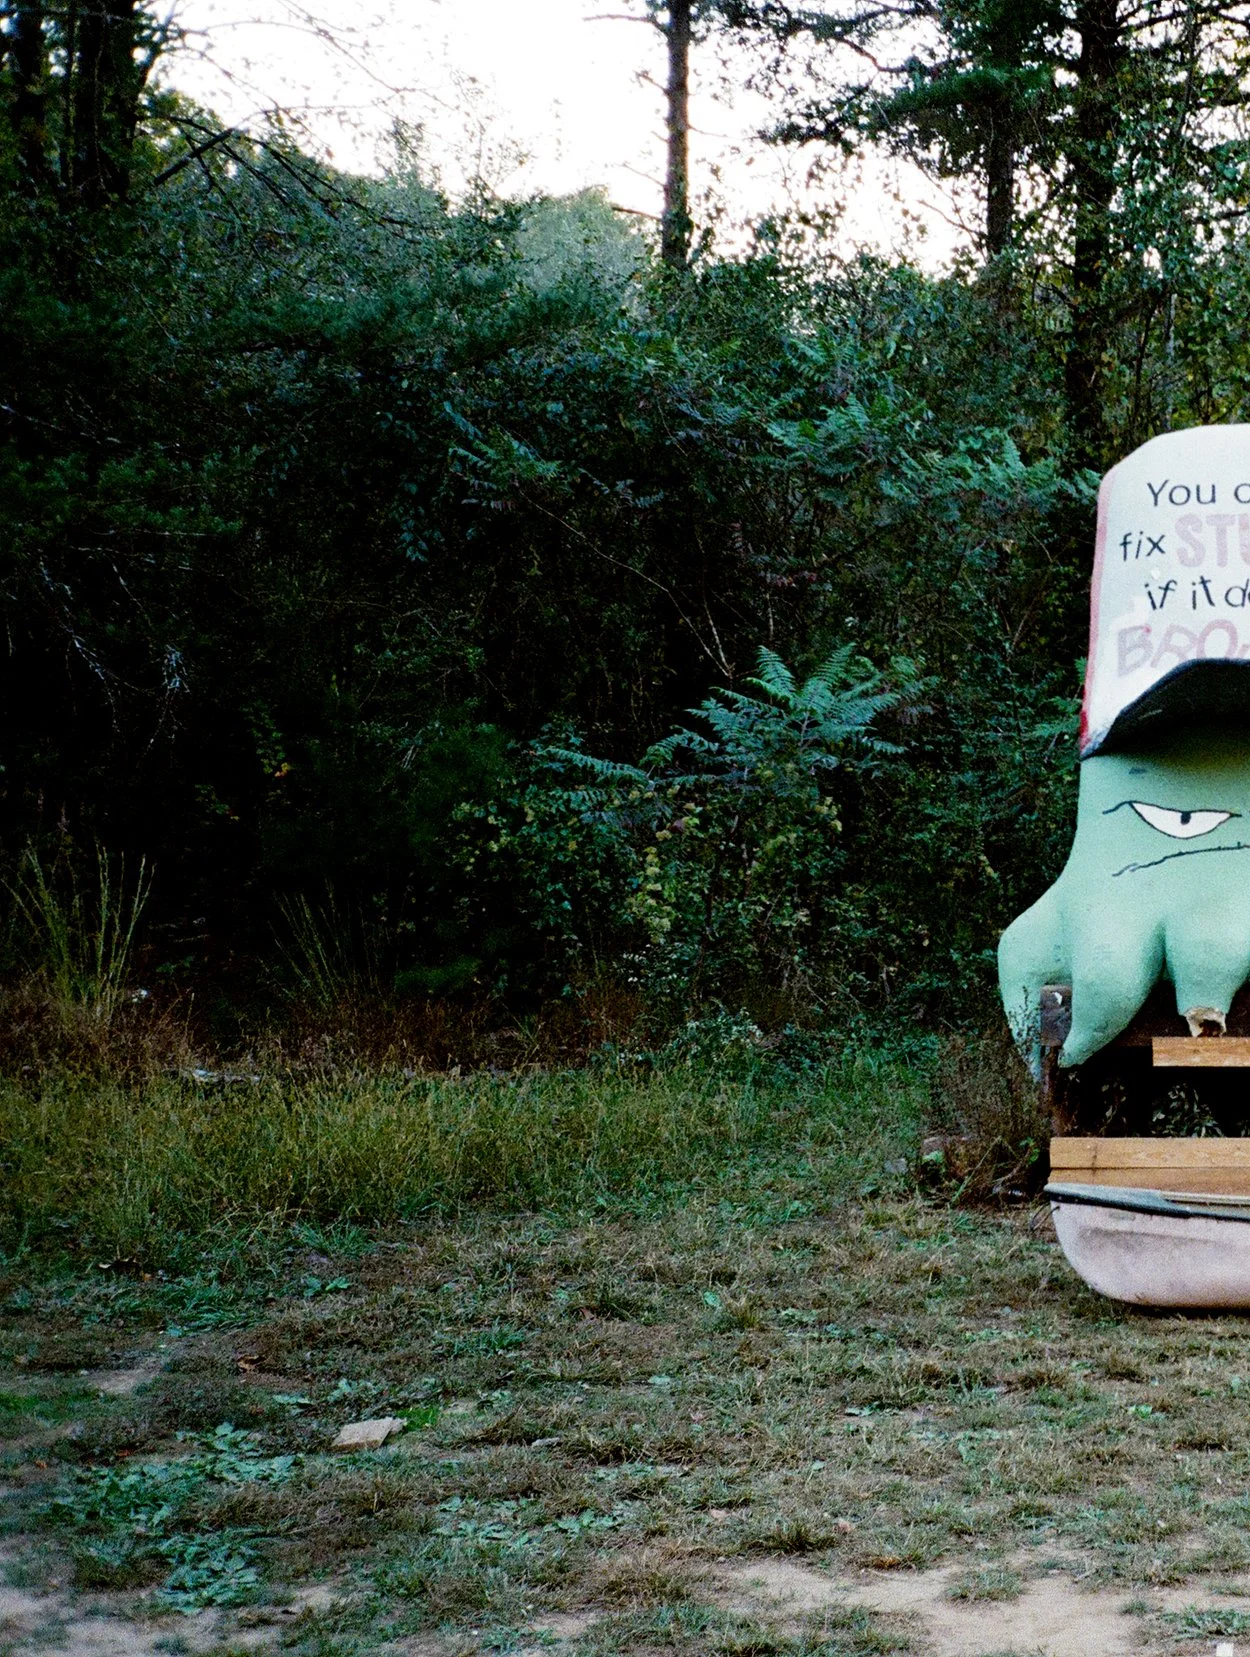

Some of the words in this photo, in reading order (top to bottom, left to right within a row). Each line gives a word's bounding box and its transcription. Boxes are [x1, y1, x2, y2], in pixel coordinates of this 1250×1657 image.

[1147, 479, 1217, 507] You
[1119, 530, 1167, 562] fix
[1144, 579, 1178, 611] if
[1191, 575, 1216, 611] it
